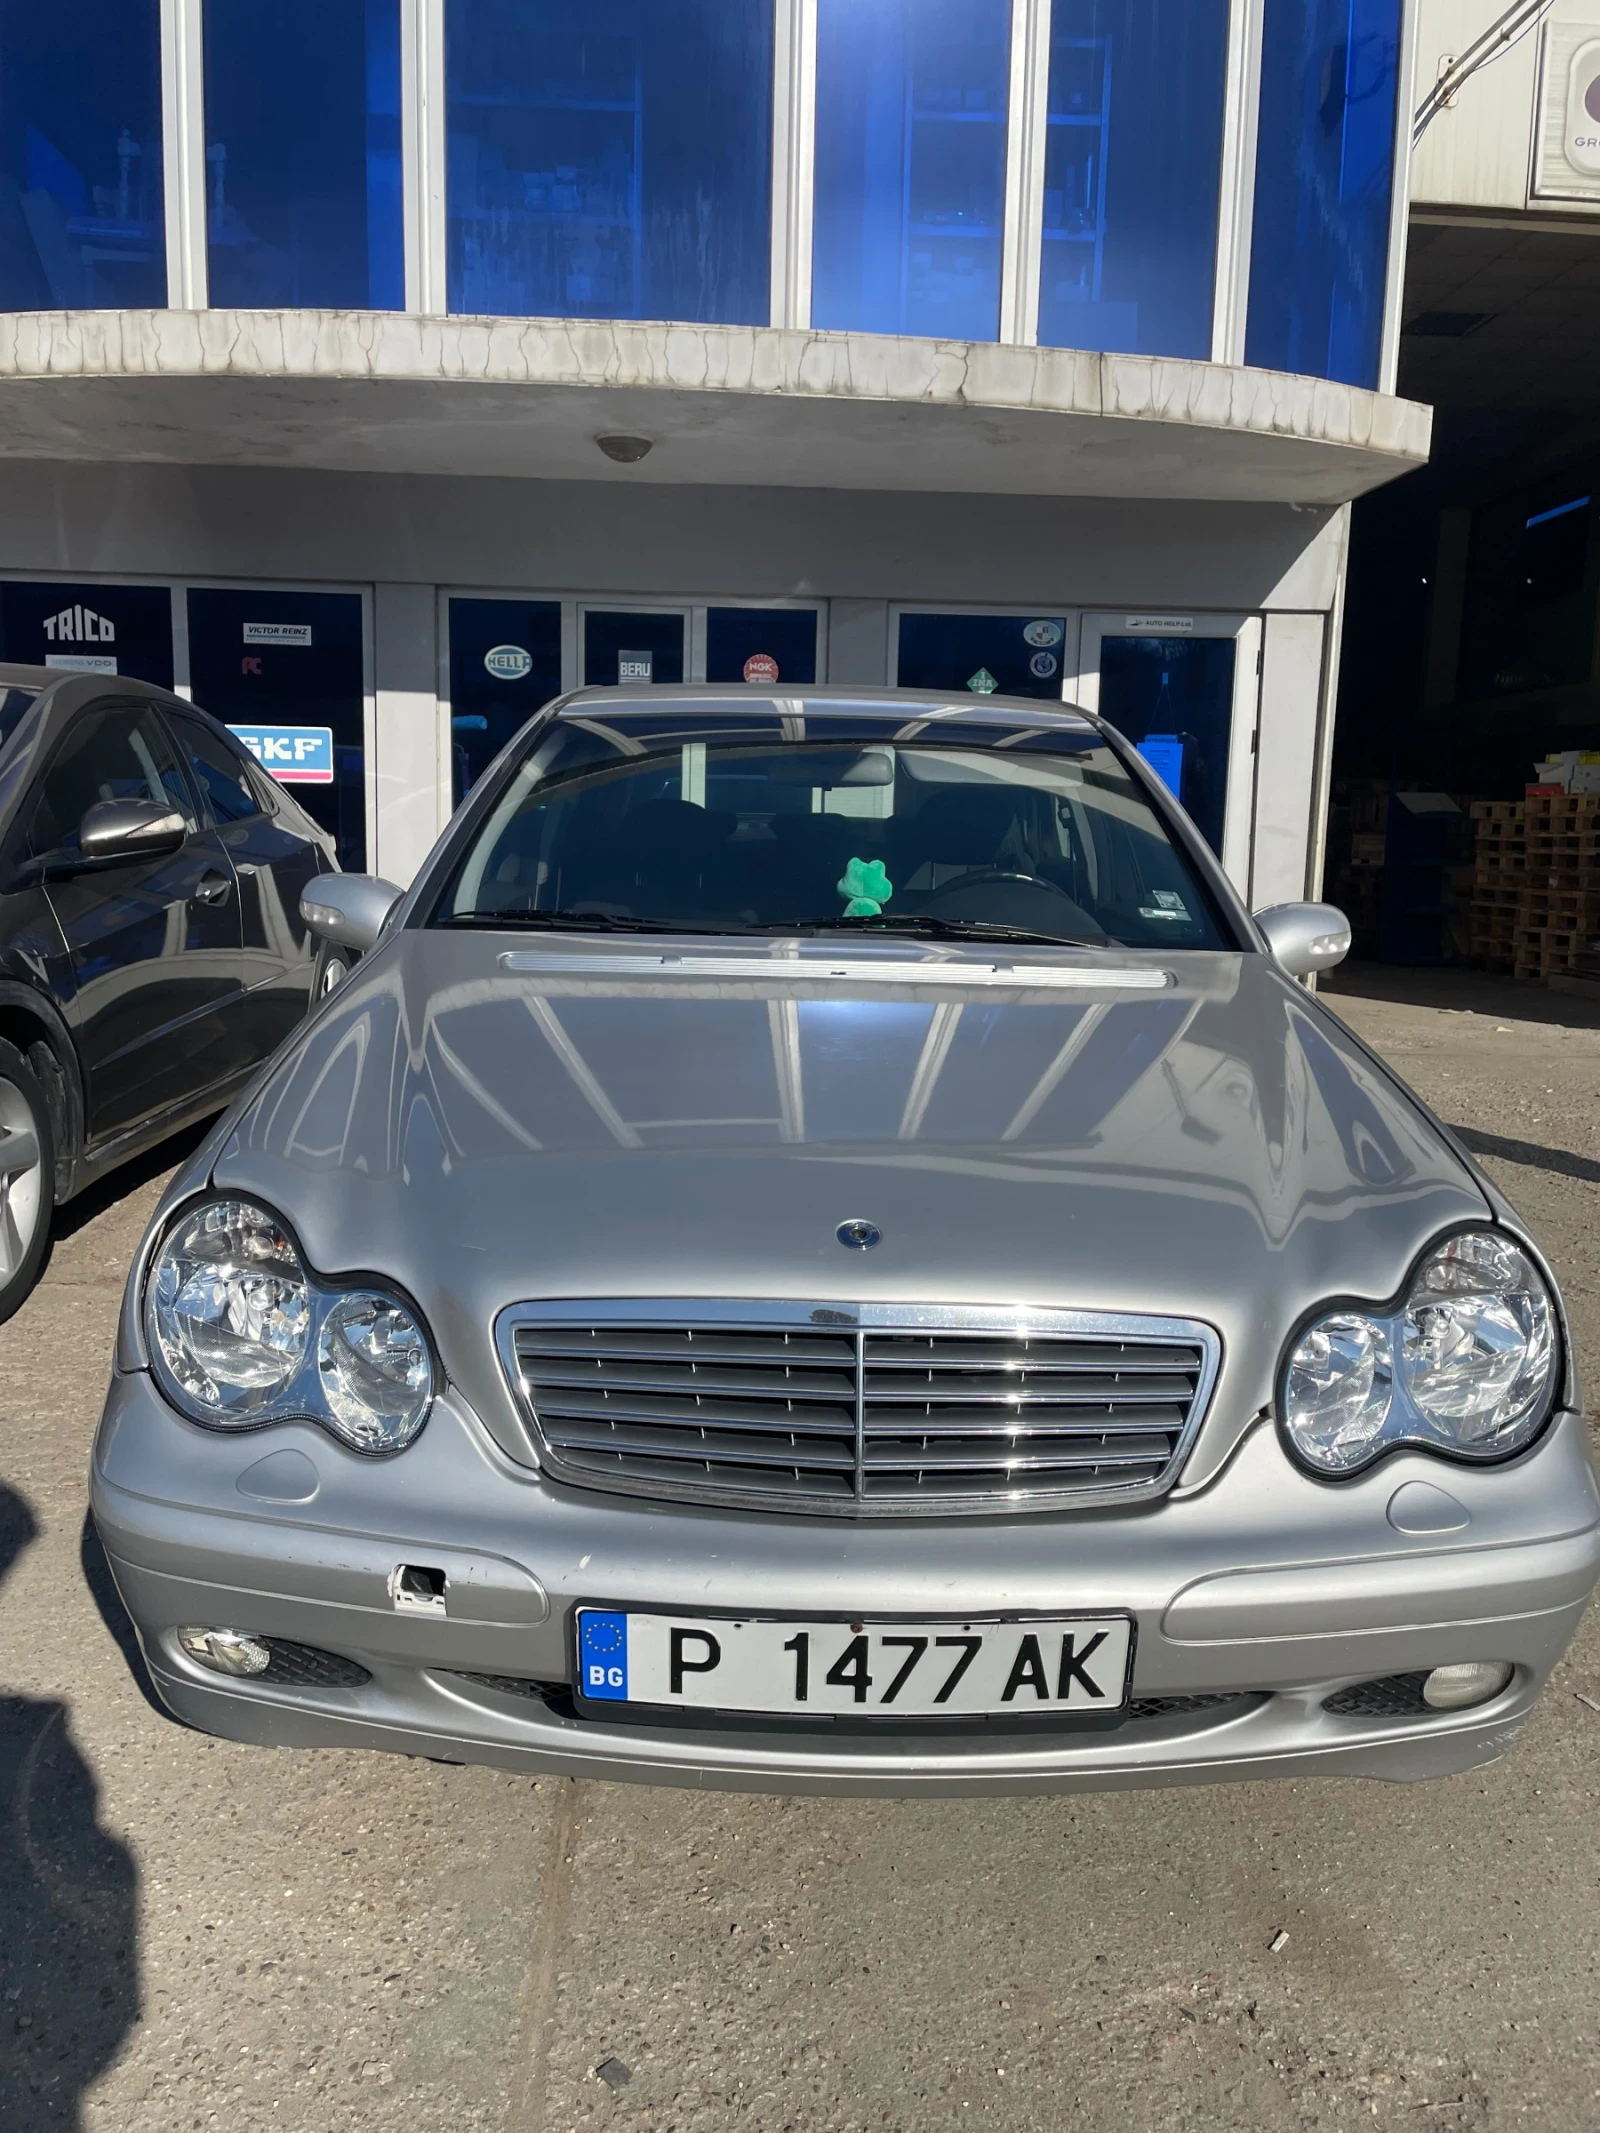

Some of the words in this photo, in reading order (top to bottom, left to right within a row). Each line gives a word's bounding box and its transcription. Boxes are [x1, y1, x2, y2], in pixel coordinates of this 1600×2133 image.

[1574, 136, 1600, 147] GR
[43, 604, 115, 641] TRICO
[248, 626, 280, 635] VICTOR
[282, 627, 308, 636] REINZ
[487, 655, 533, 670] HELLA
[620, 662, 651, 677] BERU
[749, 662, 773, 671] NGK
[972, 678, 993, 688] INA
[670, 1626, 722, 1694] P
[783, 1631, 983, 1704] 1477
[1000, 1630, 1110, 1702] AK
[589, 1666, 624, 1687] BG
